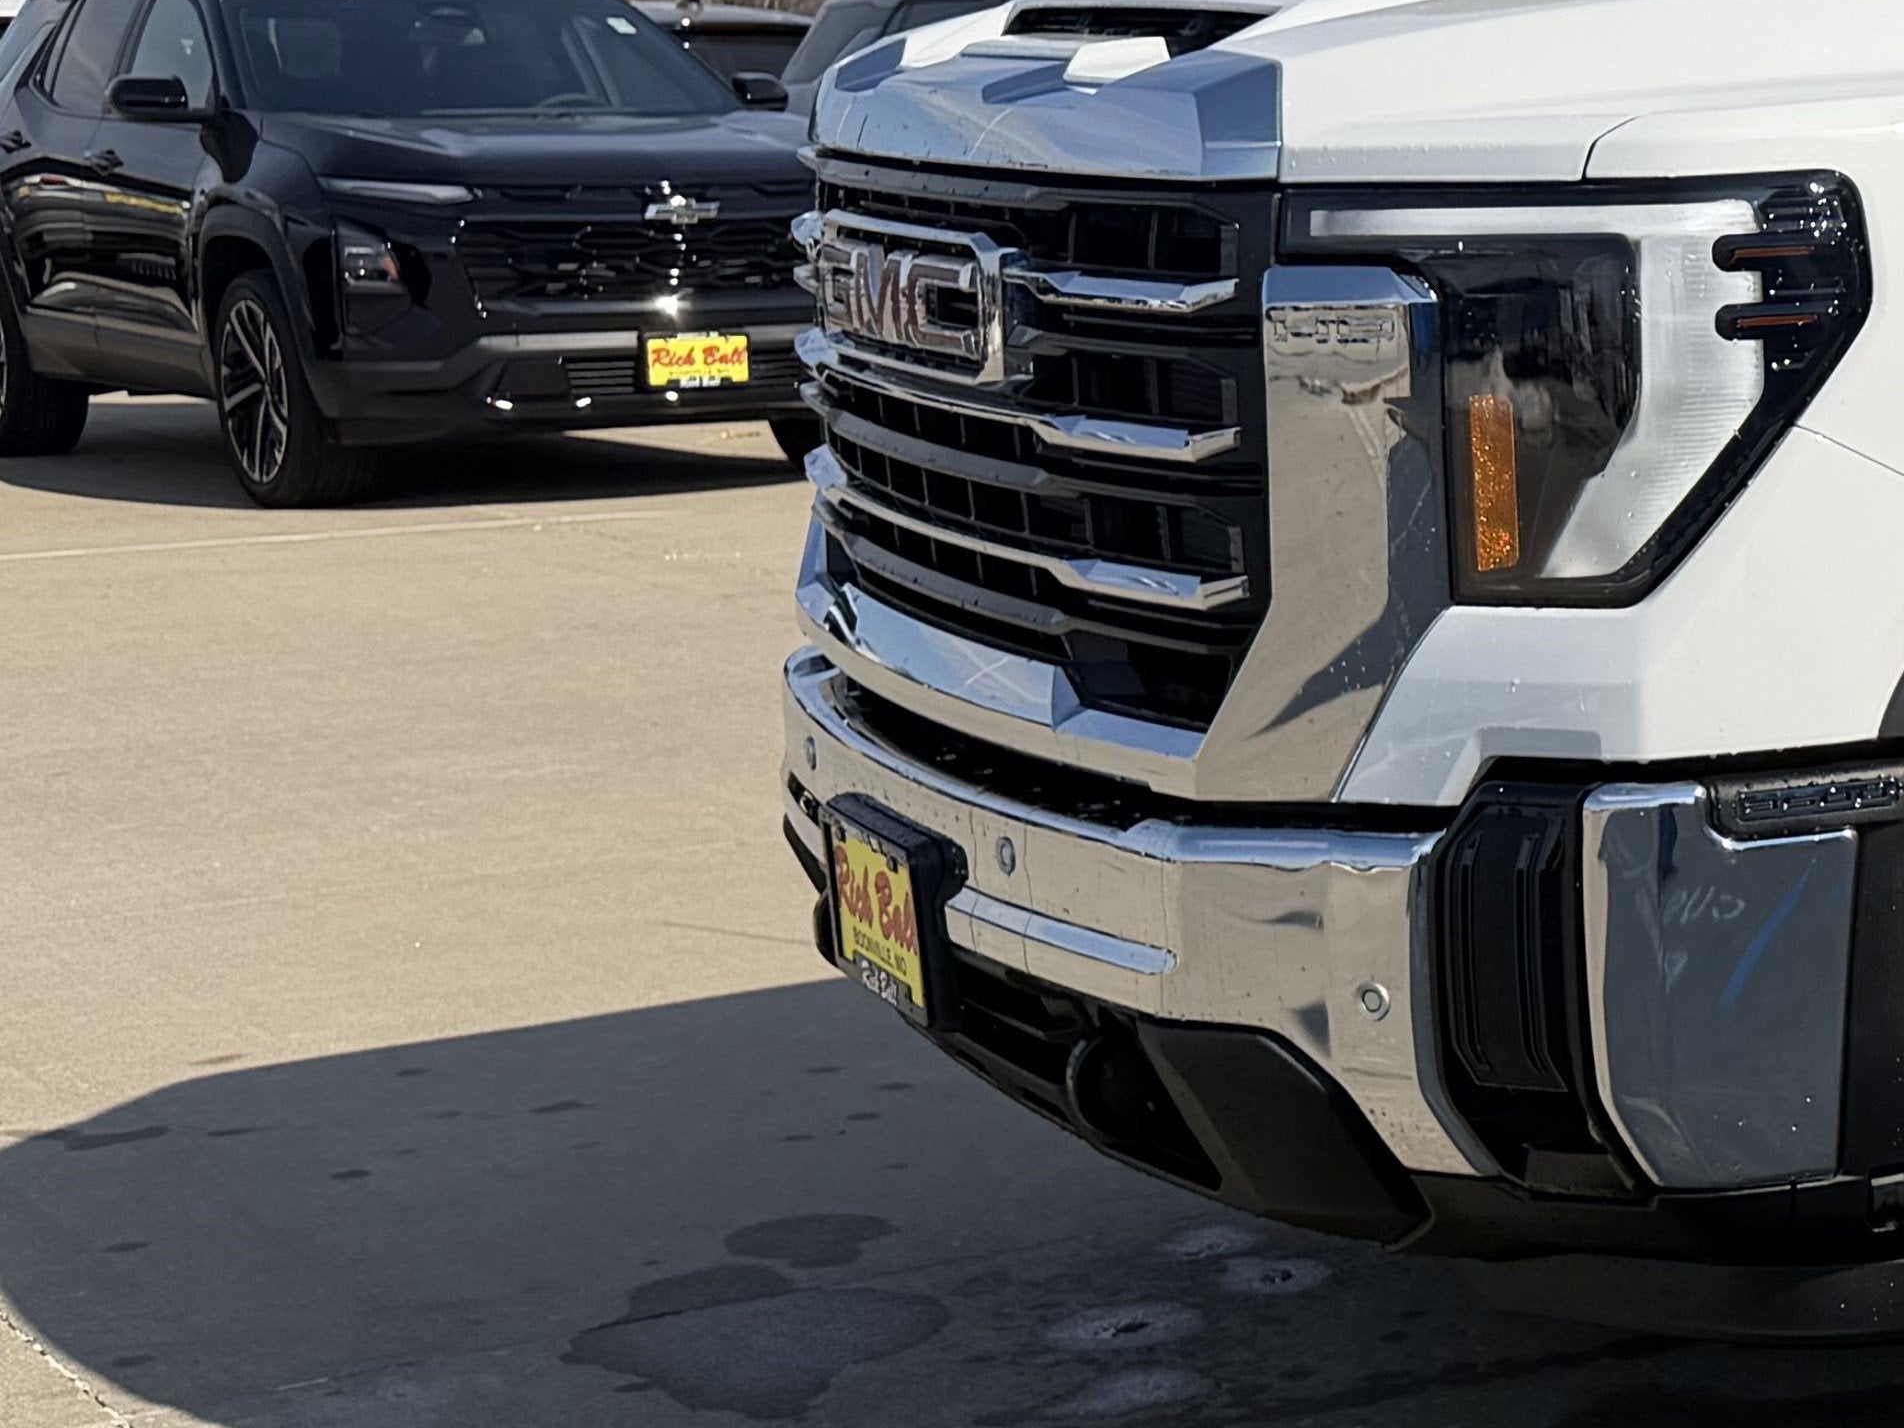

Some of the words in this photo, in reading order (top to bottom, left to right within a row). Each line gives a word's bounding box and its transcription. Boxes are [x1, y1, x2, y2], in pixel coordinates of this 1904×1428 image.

[651, 346, 696, 368] Rick
[702, 345, 748, 367] Ball
[816, 240, 980, 360] GMC
[834, 844, 875, 930] Rick
[874, 870, 919, 957] Ball
